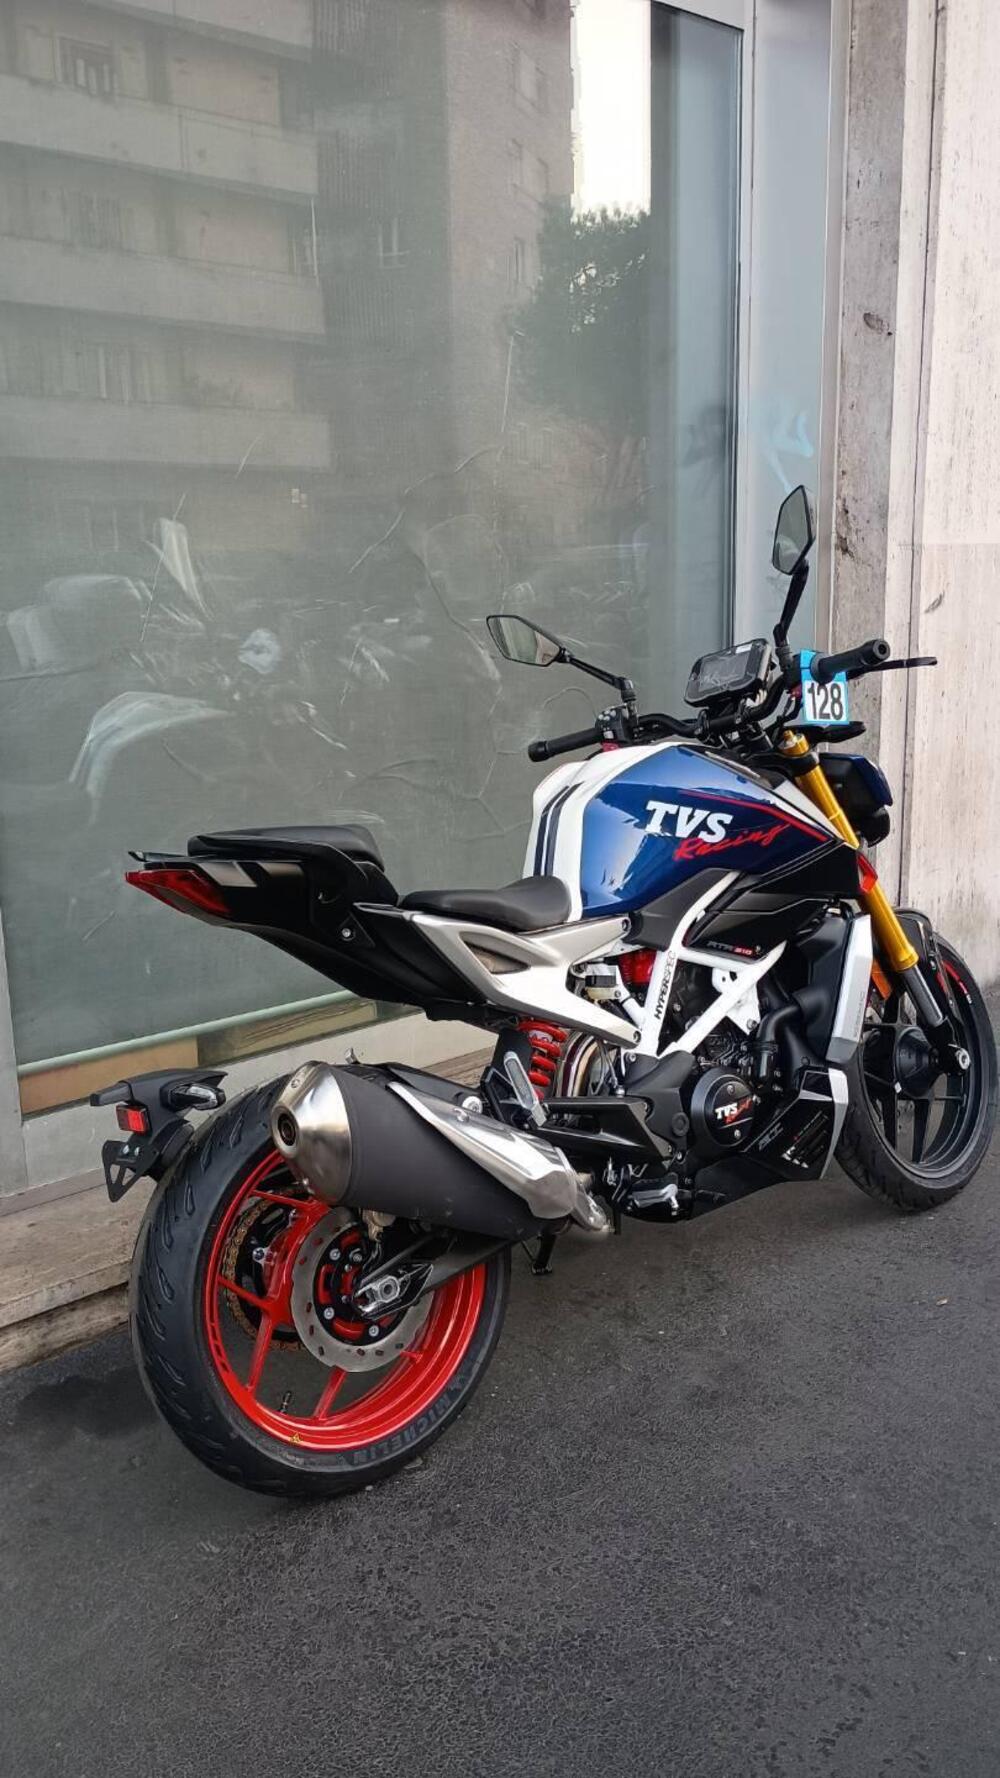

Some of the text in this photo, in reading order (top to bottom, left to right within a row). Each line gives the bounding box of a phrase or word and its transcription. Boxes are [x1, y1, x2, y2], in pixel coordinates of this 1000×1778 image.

[808, 682, 843, 720] 128
[645, 800, 734, 844] TVS
[673, 823, 790, 861] Racing
[654, 950, 677, 1020] HYPERSPEC
[715, 1102, 738, 1119] TVS
